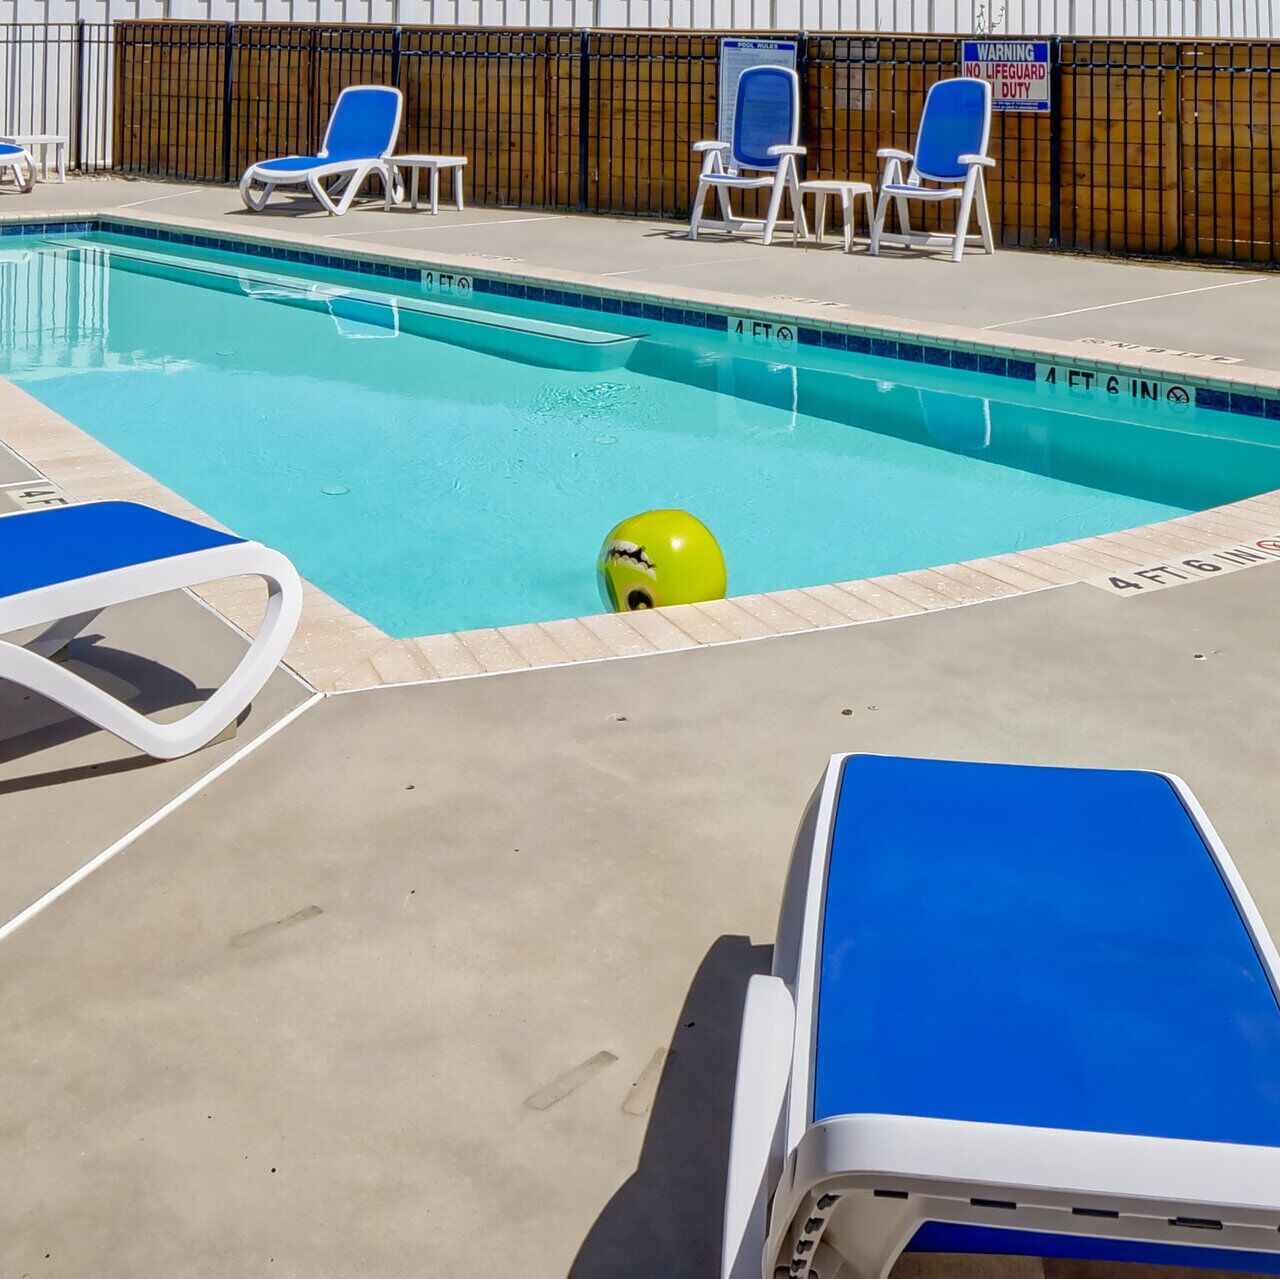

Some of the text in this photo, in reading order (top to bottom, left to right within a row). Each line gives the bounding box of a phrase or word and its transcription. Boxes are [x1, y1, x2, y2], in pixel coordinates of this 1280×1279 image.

[977, 43, 1035, 61] WARNING
[965, 63, 1046, 80] NO LIFEGUARD
[1002, 82, 1031, 98] DUTY
[753, 321, 772, 339] FT
[1045, 367, 1158, 401] 4 FT 6 IN
[19, 490, 55, 498] 4
[1108, 576, 1143, 590] 4
[1134, 566, 1188, 585] FT
[1182, 559, 1222, 572] 6
[1213, 549, 1267, 565] IN
